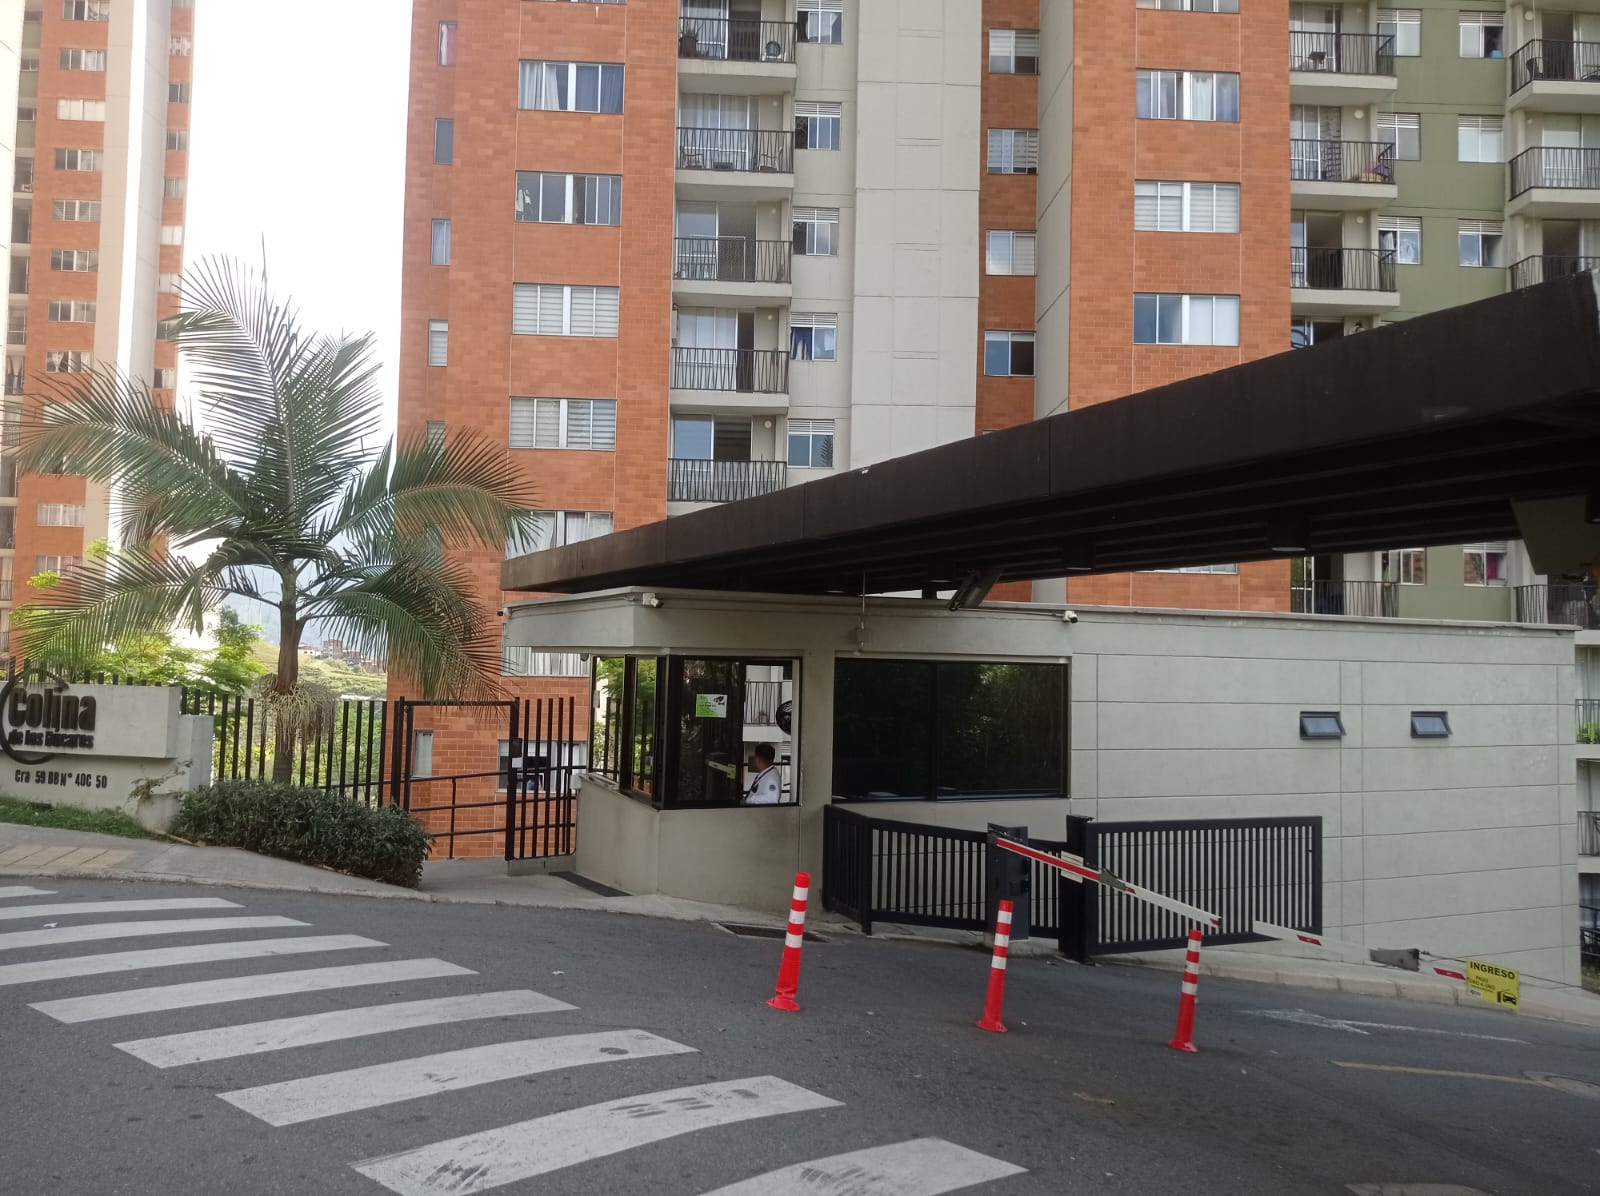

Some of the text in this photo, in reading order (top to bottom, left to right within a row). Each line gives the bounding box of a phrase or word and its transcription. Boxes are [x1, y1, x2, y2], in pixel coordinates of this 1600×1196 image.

[8, 687, 97, 731] Colina
[8, 729, 24, 746] de
[24, 730, 44, 746] los
[15, 769, 30, 783] Cra
[75, 773, 92, 787] 40C
[95, 775, 108, 789] 50
[1470, 961, 1516, 980] INGRESO
